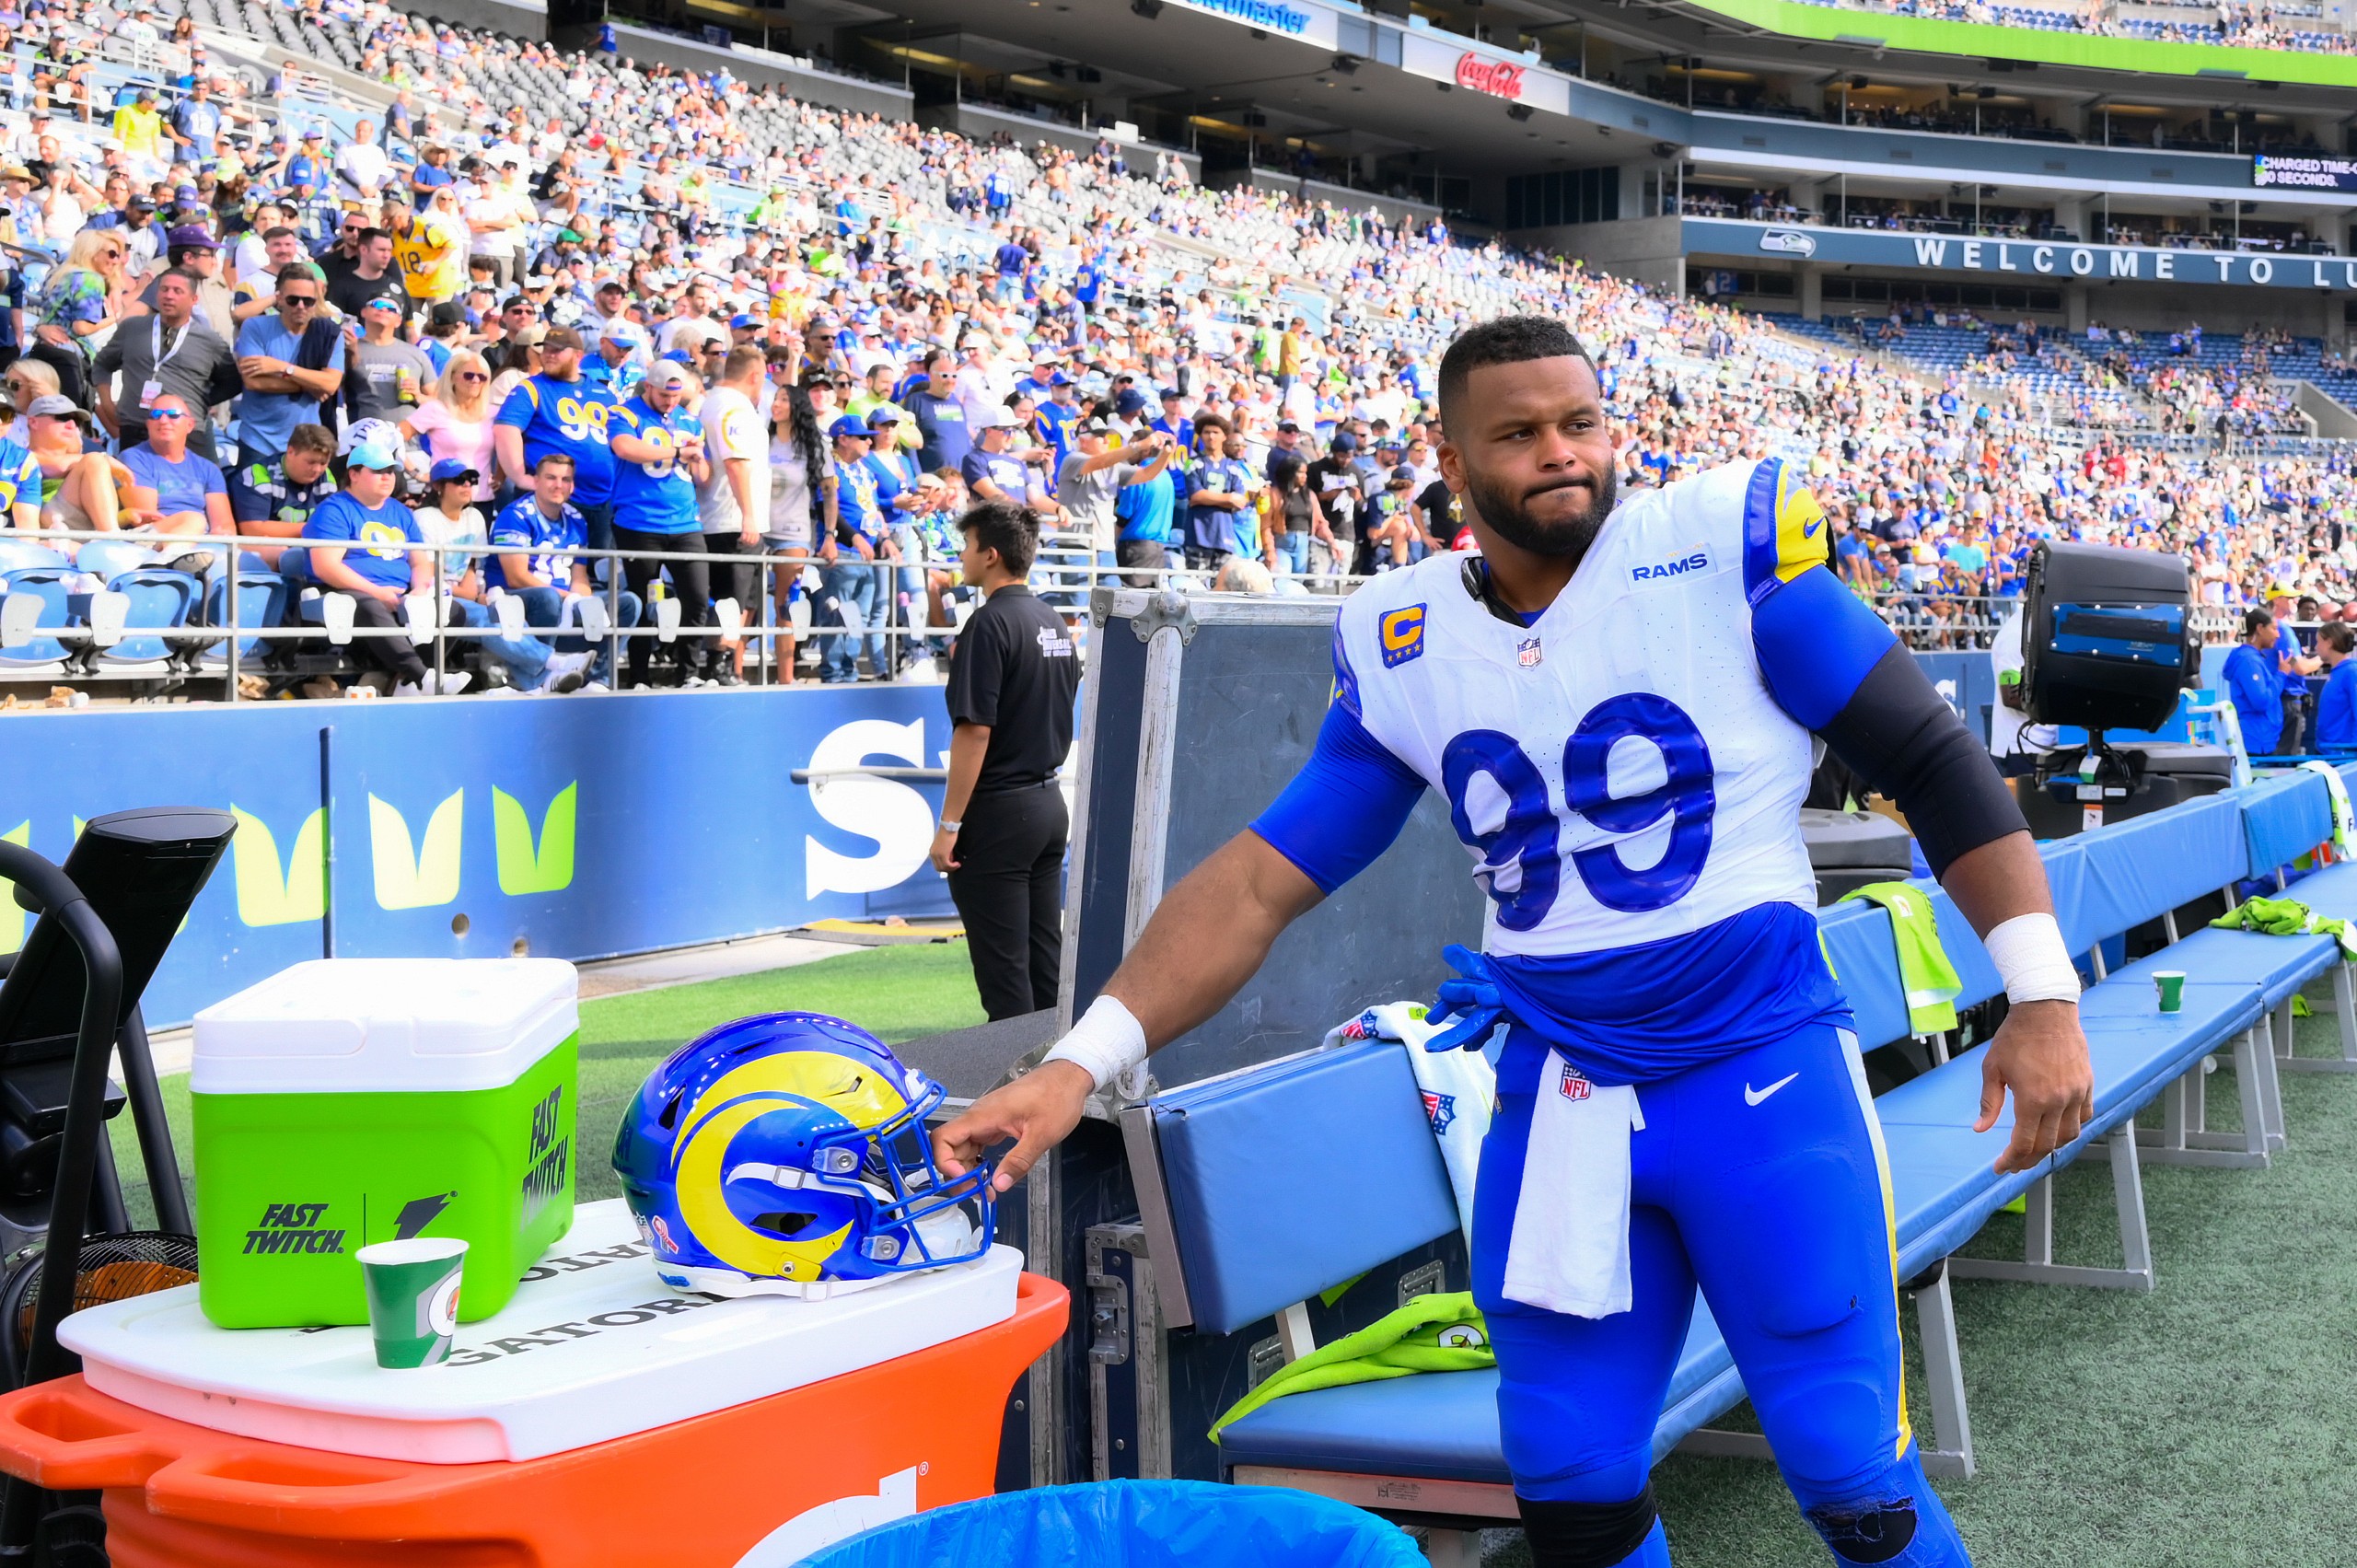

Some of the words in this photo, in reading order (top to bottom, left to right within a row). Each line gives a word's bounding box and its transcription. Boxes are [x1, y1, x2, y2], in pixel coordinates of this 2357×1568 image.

[1185, 0, 1310, 34] master
[2260, 156, 2320, 173] CHARGED
[1914, 238, 2174, 279] WELCOME
[2213, 256, 2272, 285] TO
[1631, 552, 1708, 582] RAMS
[1382, 607, 1423, 651] C
[1518, 647, 1542, 666] NFL
[1441, 692, 1716, 931] 99
[1562, 1077, 1588, 1099] NFL
[528, 1083, 563, 1165] FAST
[519, 1134, 569, 1234] TWITCH
[259, 1203, 329, 1227] FAST
